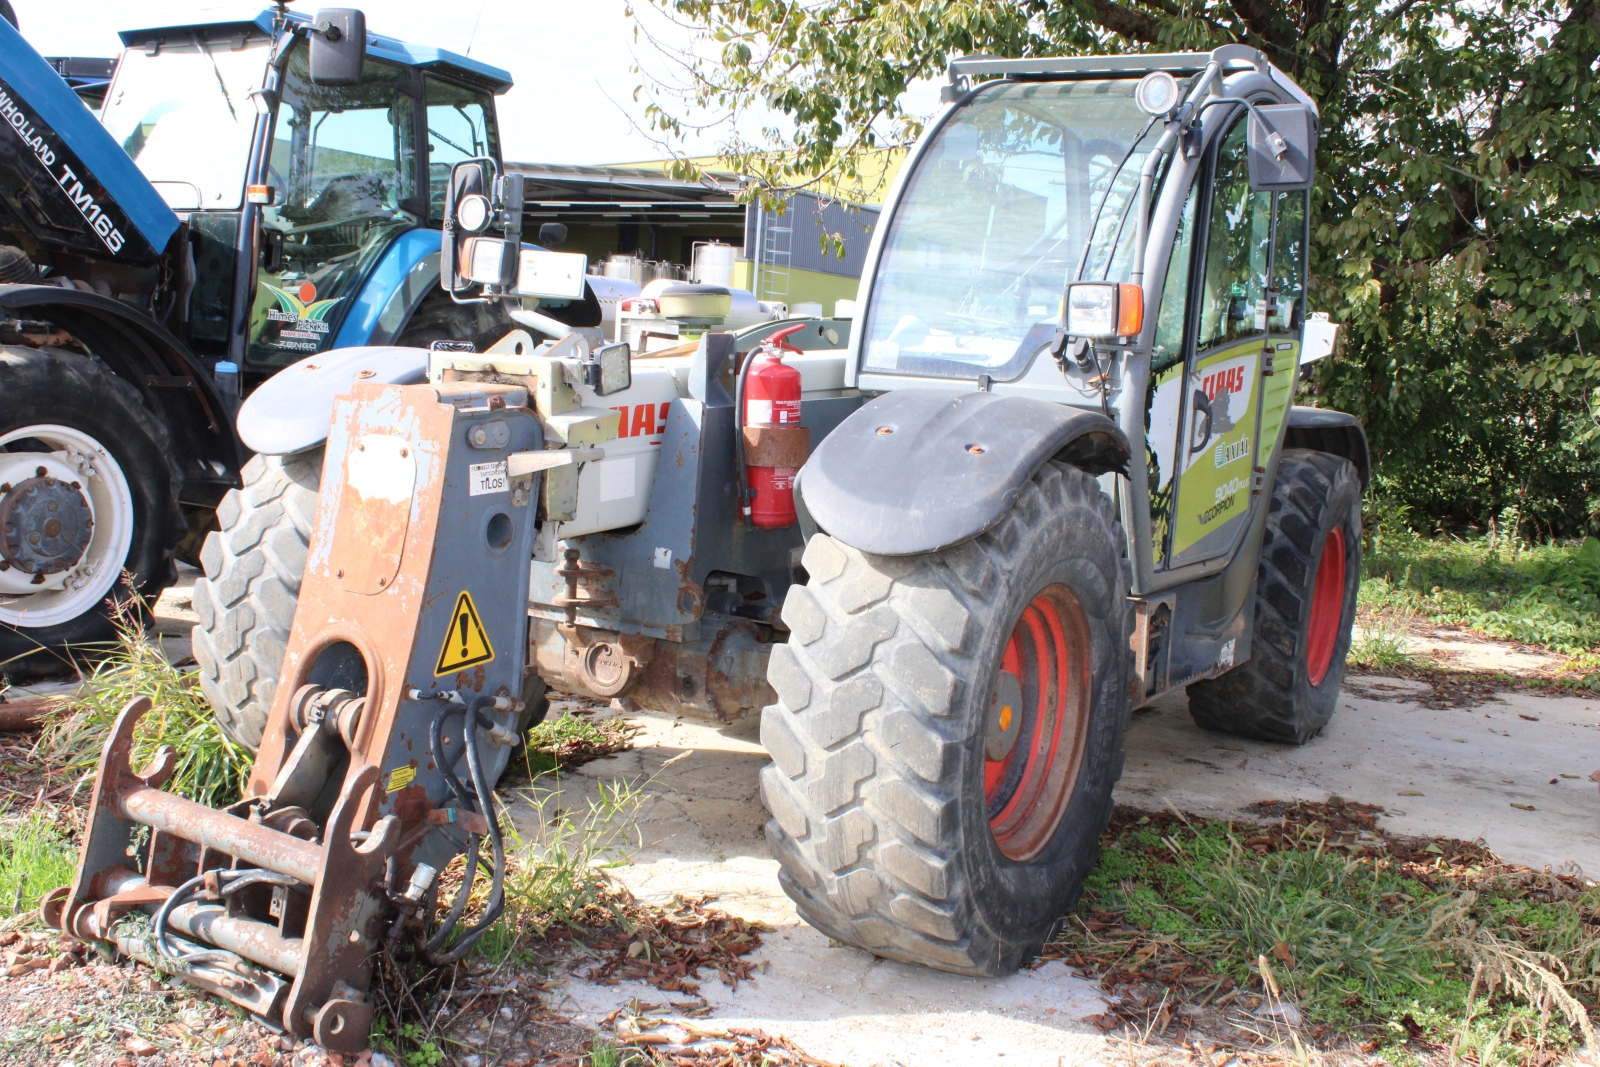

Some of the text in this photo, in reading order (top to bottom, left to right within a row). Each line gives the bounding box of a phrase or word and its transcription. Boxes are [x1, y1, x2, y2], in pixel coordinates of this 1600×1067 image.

[59, 164, 126, 252] TM165
[1202, 365, 1245, 401] CLAAS
[480, 478, 505, 490] TILOS!
